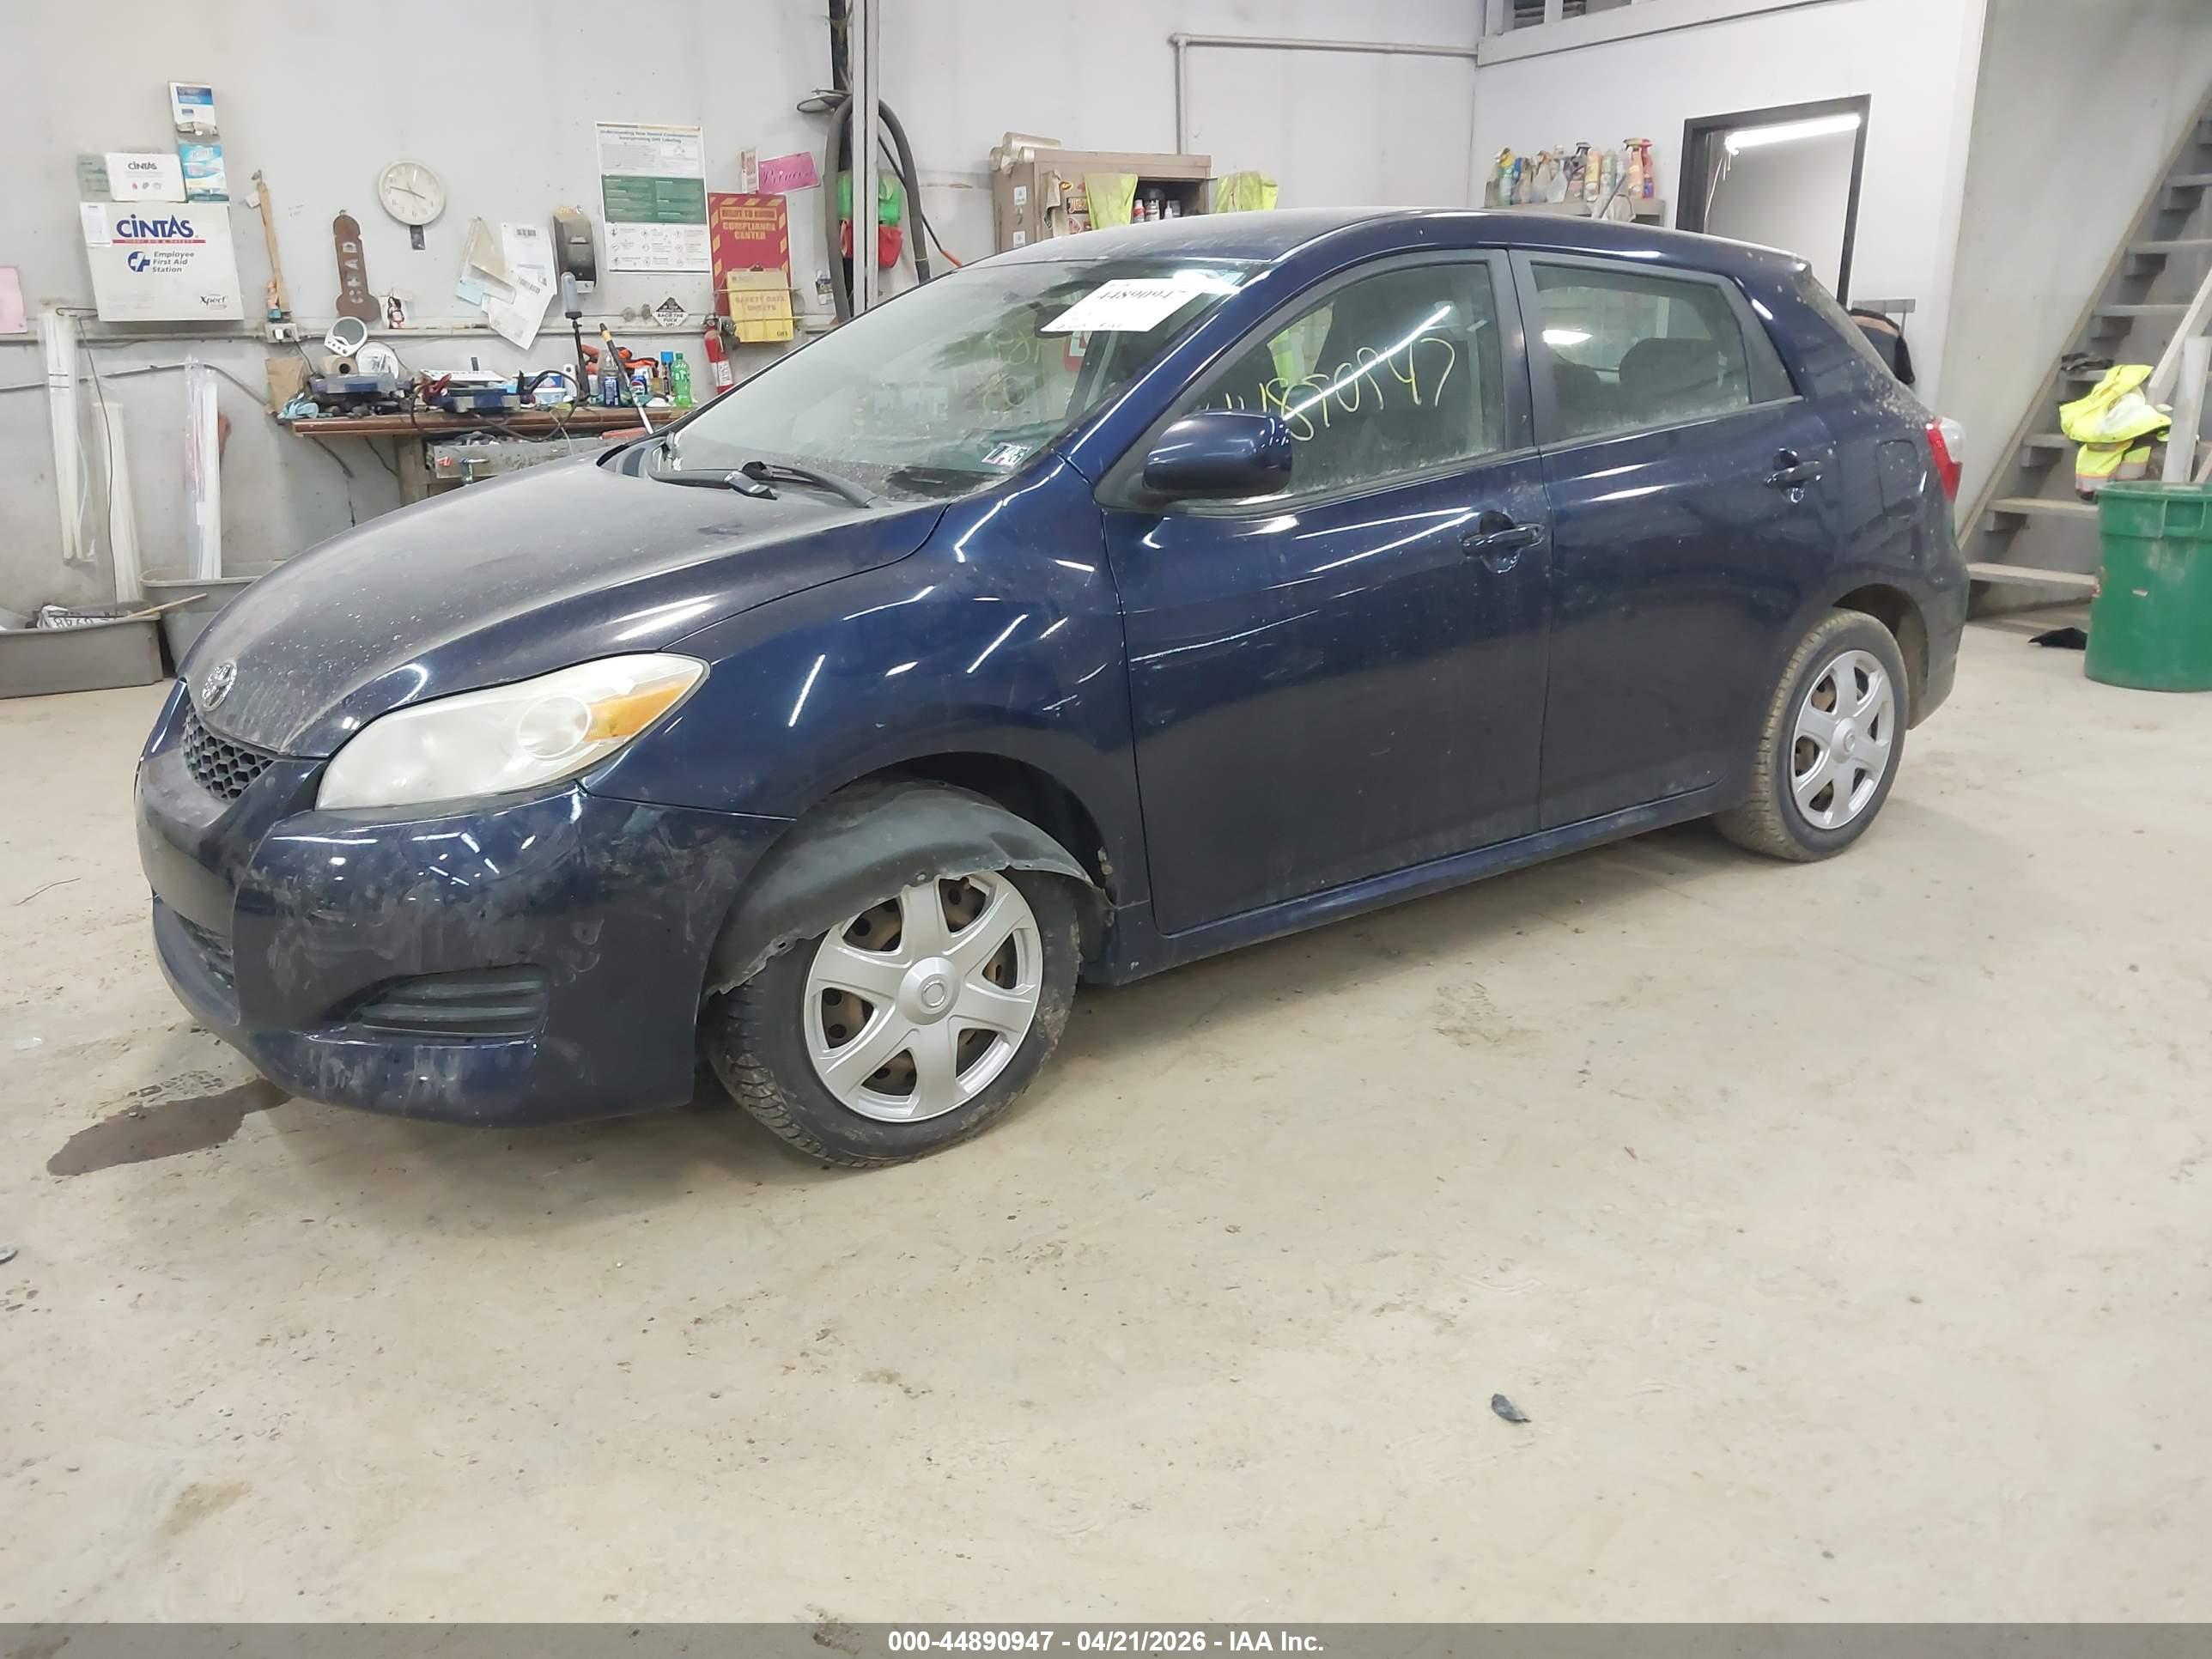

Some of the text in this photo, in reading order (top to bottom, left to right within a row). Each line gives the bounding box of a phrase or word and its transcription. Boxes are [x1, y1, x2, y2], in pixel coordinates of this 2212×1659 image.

[128, 161, 157, 170] CINTAS
[116, 213, 194, 238] CINTAS
[722, 222, 776, 231] COMPLIANCE
[734, 231, 766, 240] CENTER
